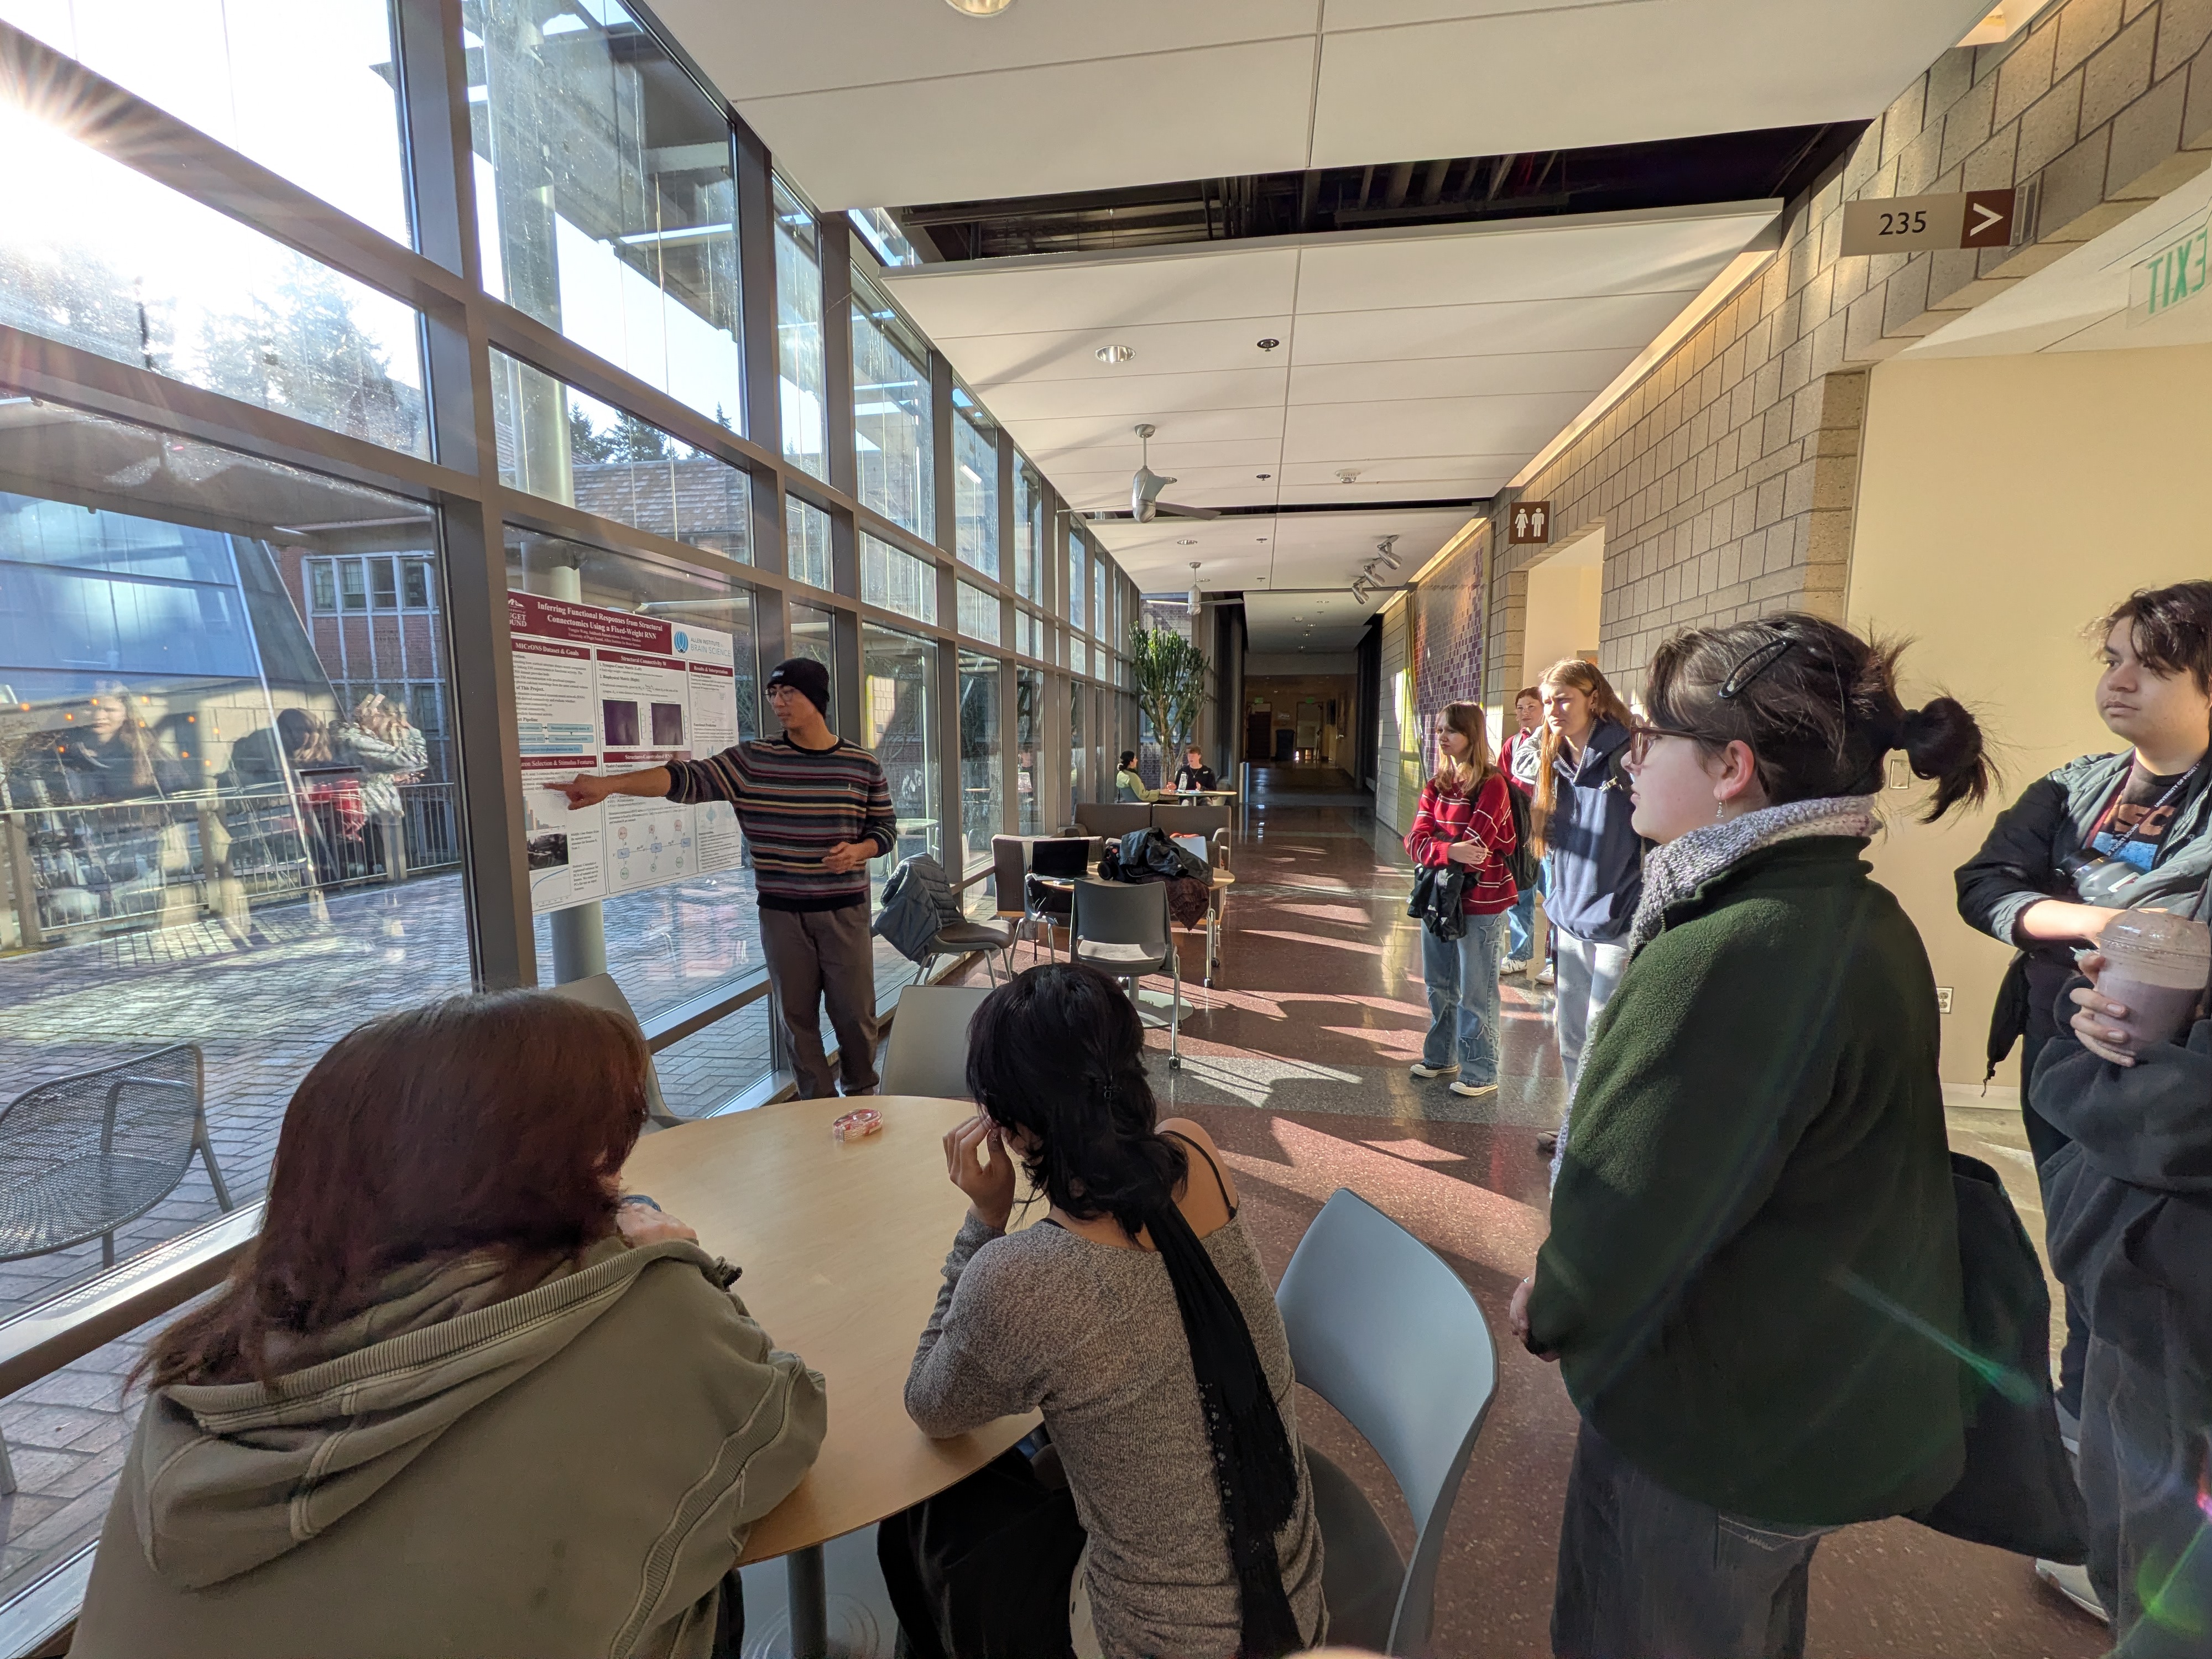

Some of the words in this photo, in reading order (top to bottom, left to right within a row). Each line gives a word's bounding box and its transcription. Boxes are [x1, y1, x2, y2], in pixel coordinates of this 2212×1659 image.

[1879, 211, 1927, 236] 235
[538, 602, 566, 615] Inferring
[567, 607, 597, 619] Functional
[599, 613, 625, 624] Responses
[639, 621, 662, 631] Structural
[547, 614, 589, 628] Connectomics
[589, 622, 605, 632] Using
[611, 625, 644, 638] Fixed-Weight
[515, 643, 542, 651] MICrONS
[691, 644, 707, 653] BRAIN
[708, 648, 731, 657] SCIENCE
[2154, 785, 2178, 807] UNIVERSITY
[2182, 766, 2198, 780] PUGET
[2111, 837, 2126, 851] PUGET
[2124, 823, 2139, 838] SOUND
